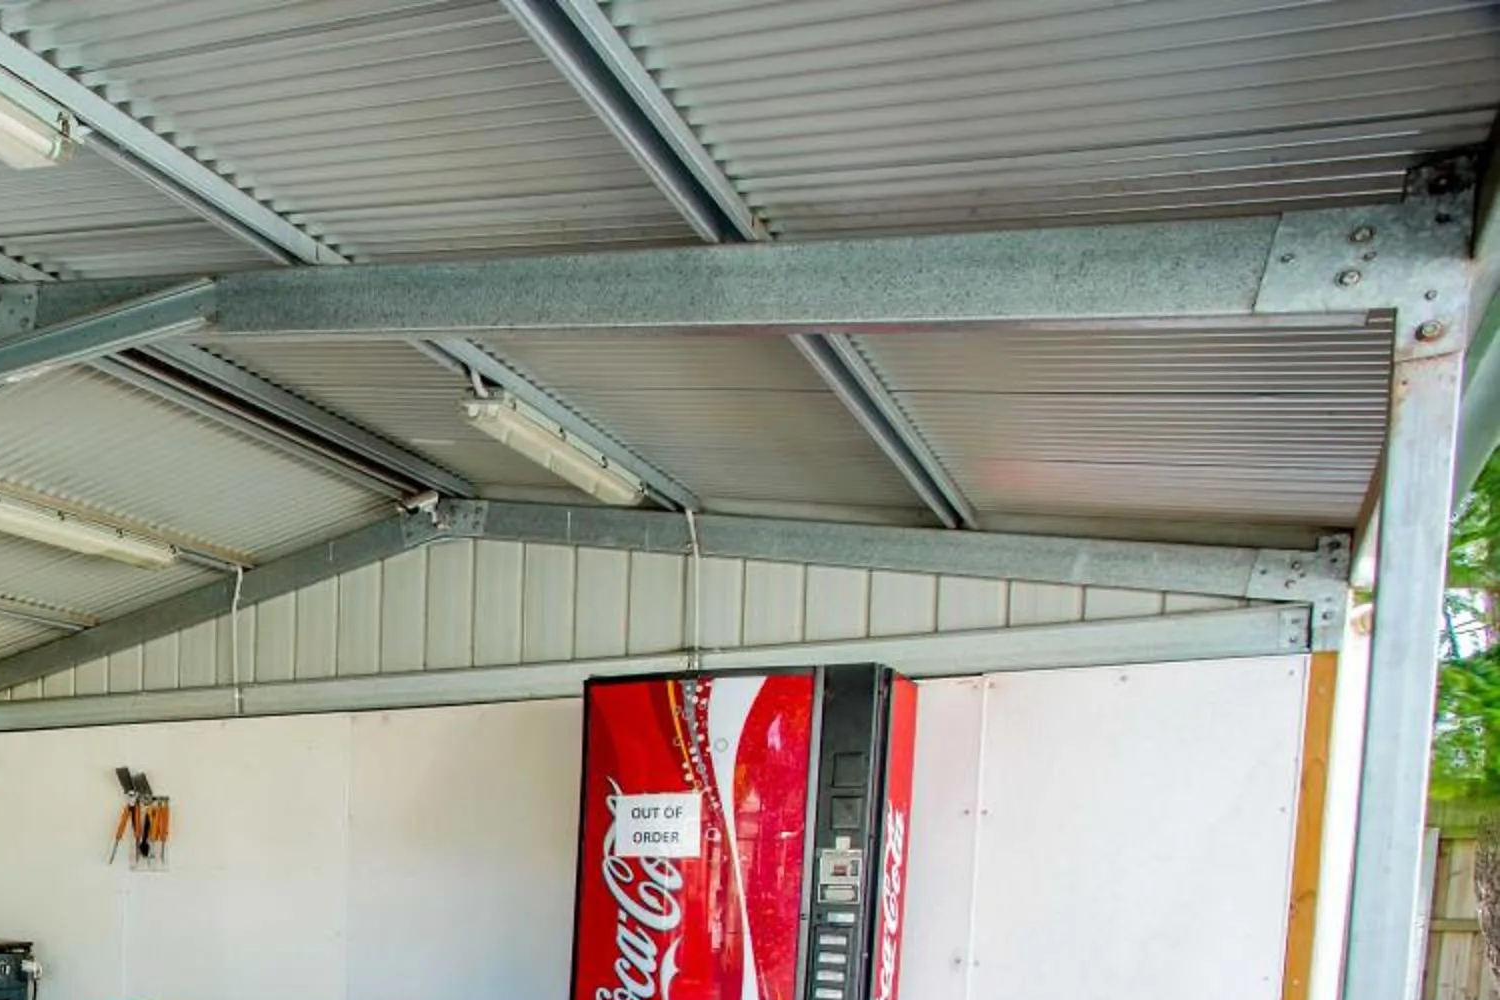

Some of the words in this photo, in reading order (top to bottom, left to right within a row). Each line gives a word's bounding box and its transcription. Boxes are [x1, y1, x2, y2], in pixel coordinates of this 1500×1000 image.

[631, 807, 660, 819] OUT
[663, 806, 683, 819] OF
[633, 831, 680, 844] ORDER
